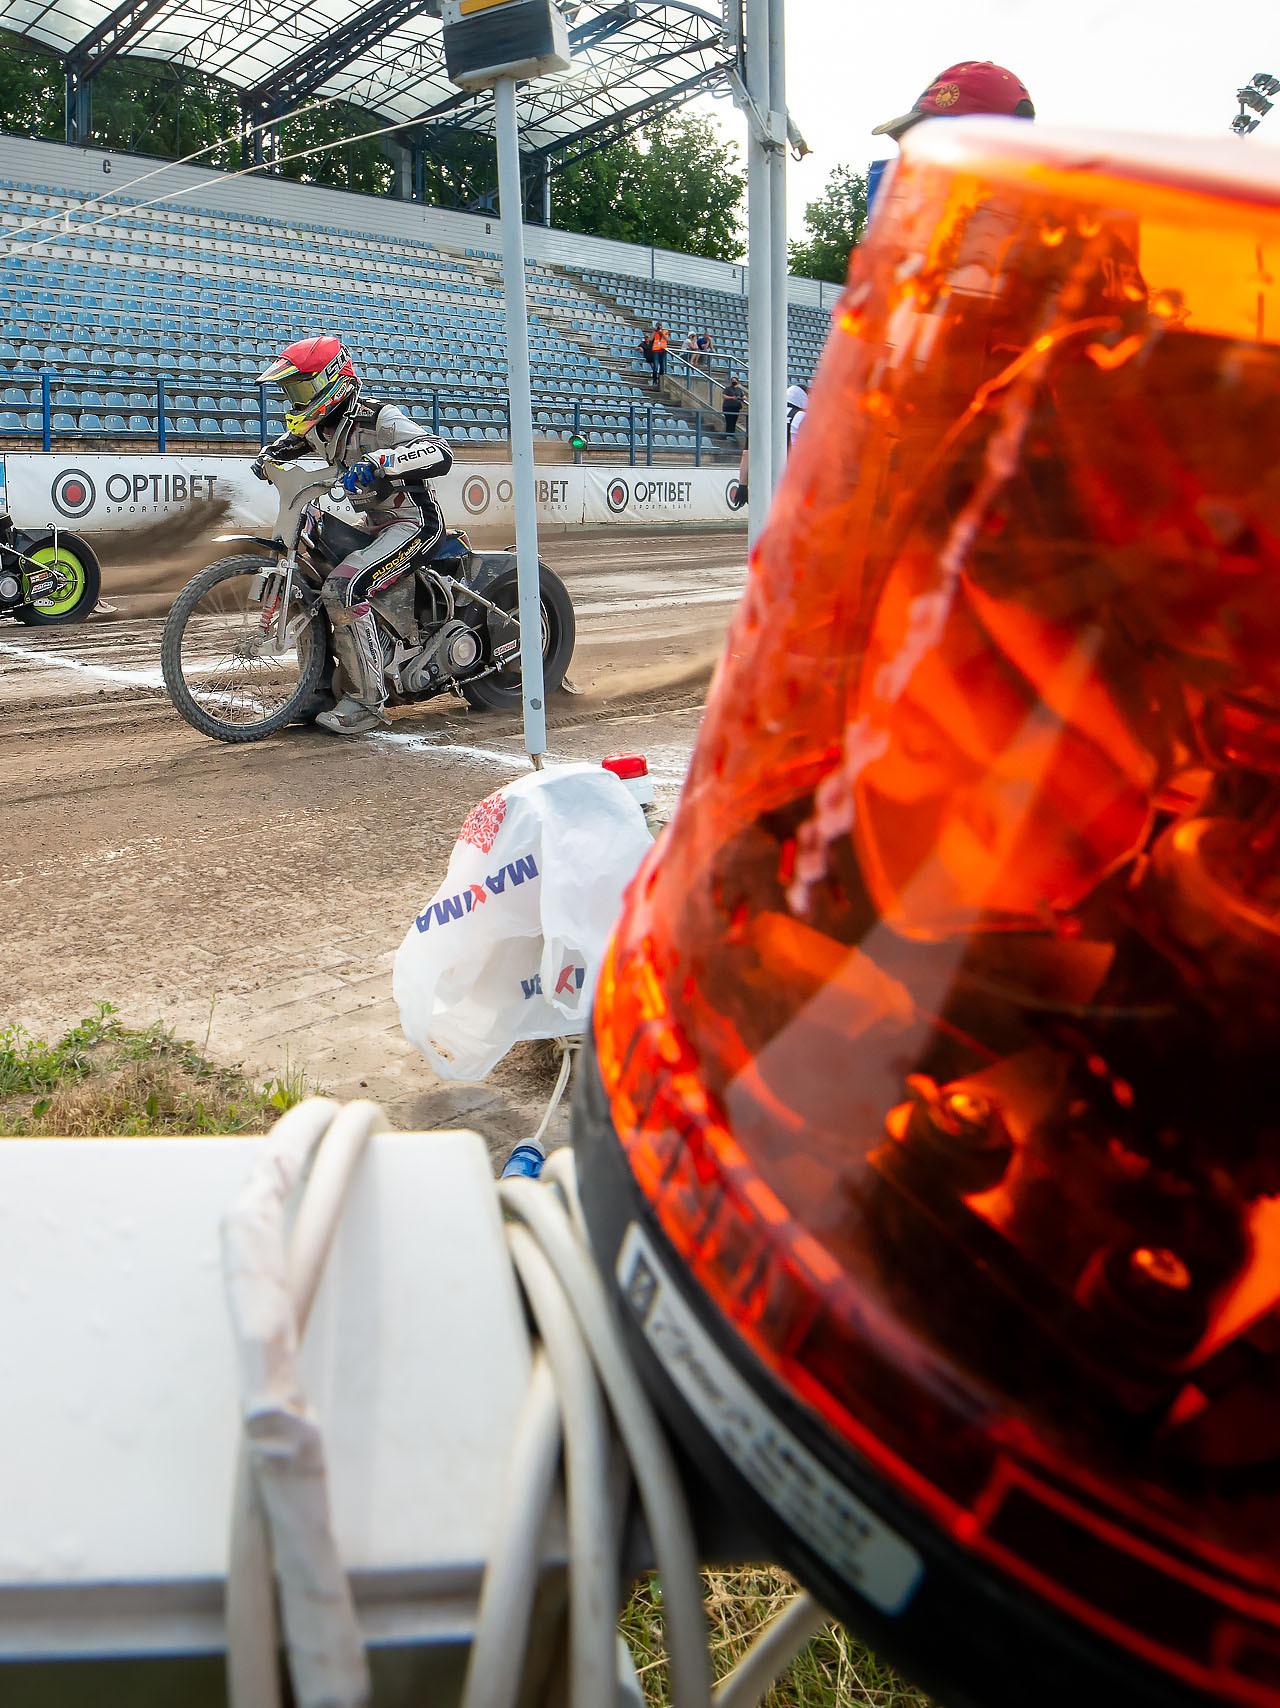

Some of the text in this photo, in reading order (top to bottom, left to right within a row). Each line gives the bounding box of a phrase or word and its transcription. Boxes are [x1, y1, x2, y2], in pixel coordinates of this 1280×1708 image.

[397, 445, 437, 464] RENO
[105, 473, 218, 502] OPTIBET
[496, 479, 569, 503] OIBET
[634, 481, 692, 503] OPTIBET
[106, 506, 169, 514] SPORTA
[415, 854, 539, 933] MAXIMA
